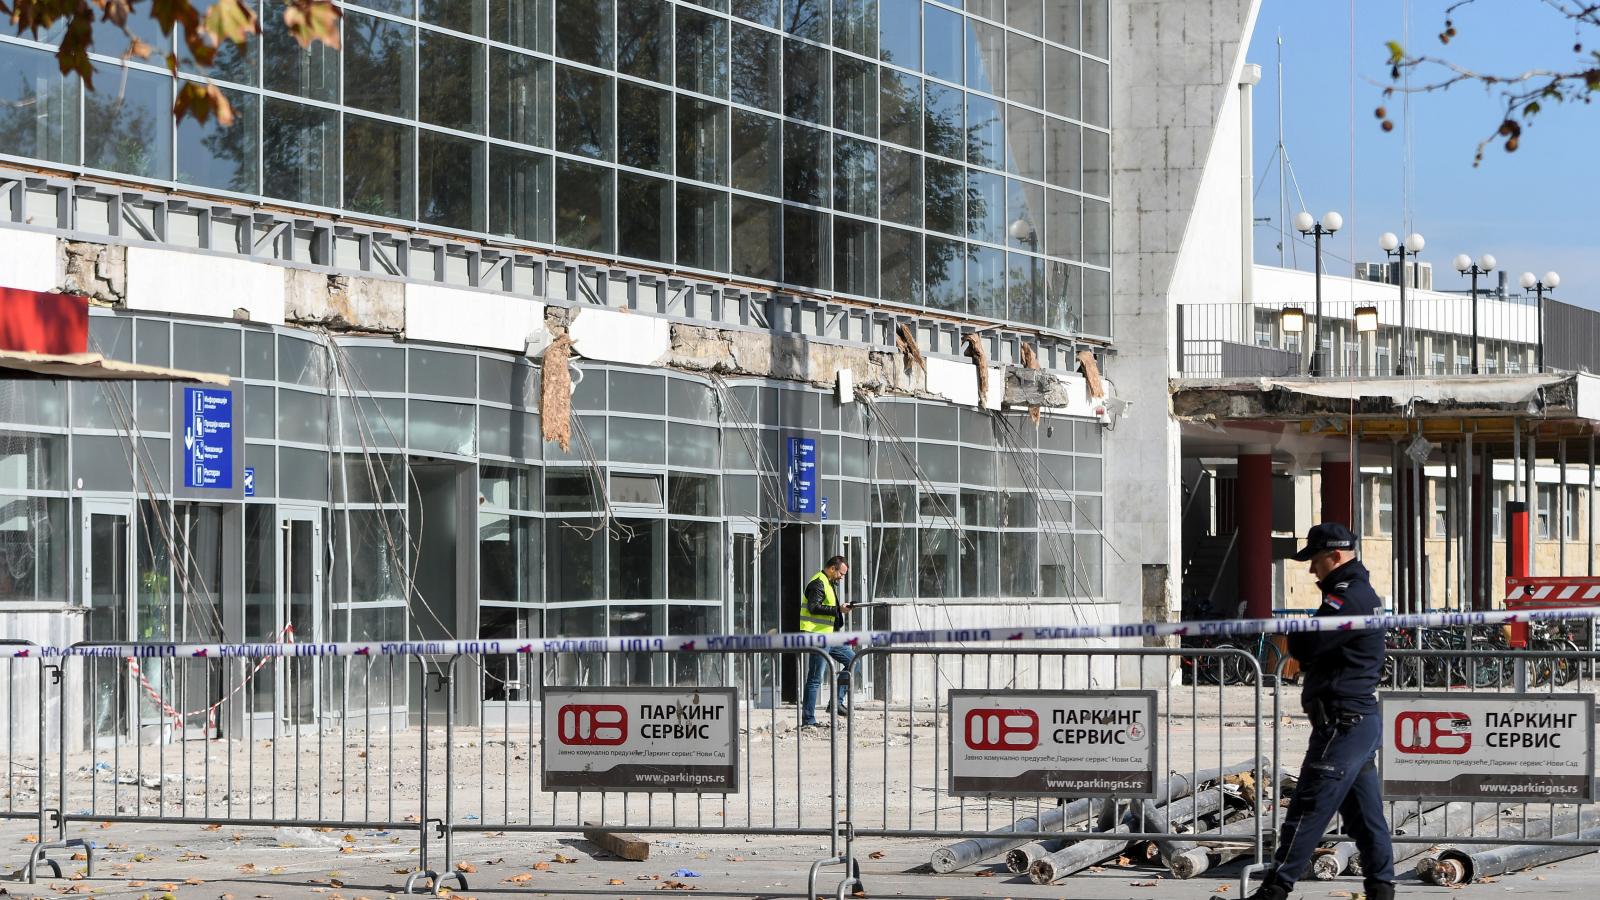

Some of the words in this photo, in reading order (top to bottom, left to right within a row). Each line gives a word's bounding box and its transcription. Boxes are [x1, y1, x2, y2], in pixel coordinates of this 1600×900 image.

[641, 705, 724, 720] ПАРКИНГ
[1053, 709, 1141, 725] ПАРКИНГ
[1486, 712, 1577, 728] ПАРКИНГ
[641, 724, 709, 739] СЕРВИС
[1053, 729, 1125, 744] СЕРВИС
[1486, 732, 1561, 748] СЕРВИС
[636, 773, 725, 785] www.parkingns.rs
[1047, 778, 1142, 791] www.parkingns.rs
[1480, 781, 1578, 794] www.parkingns.rs
